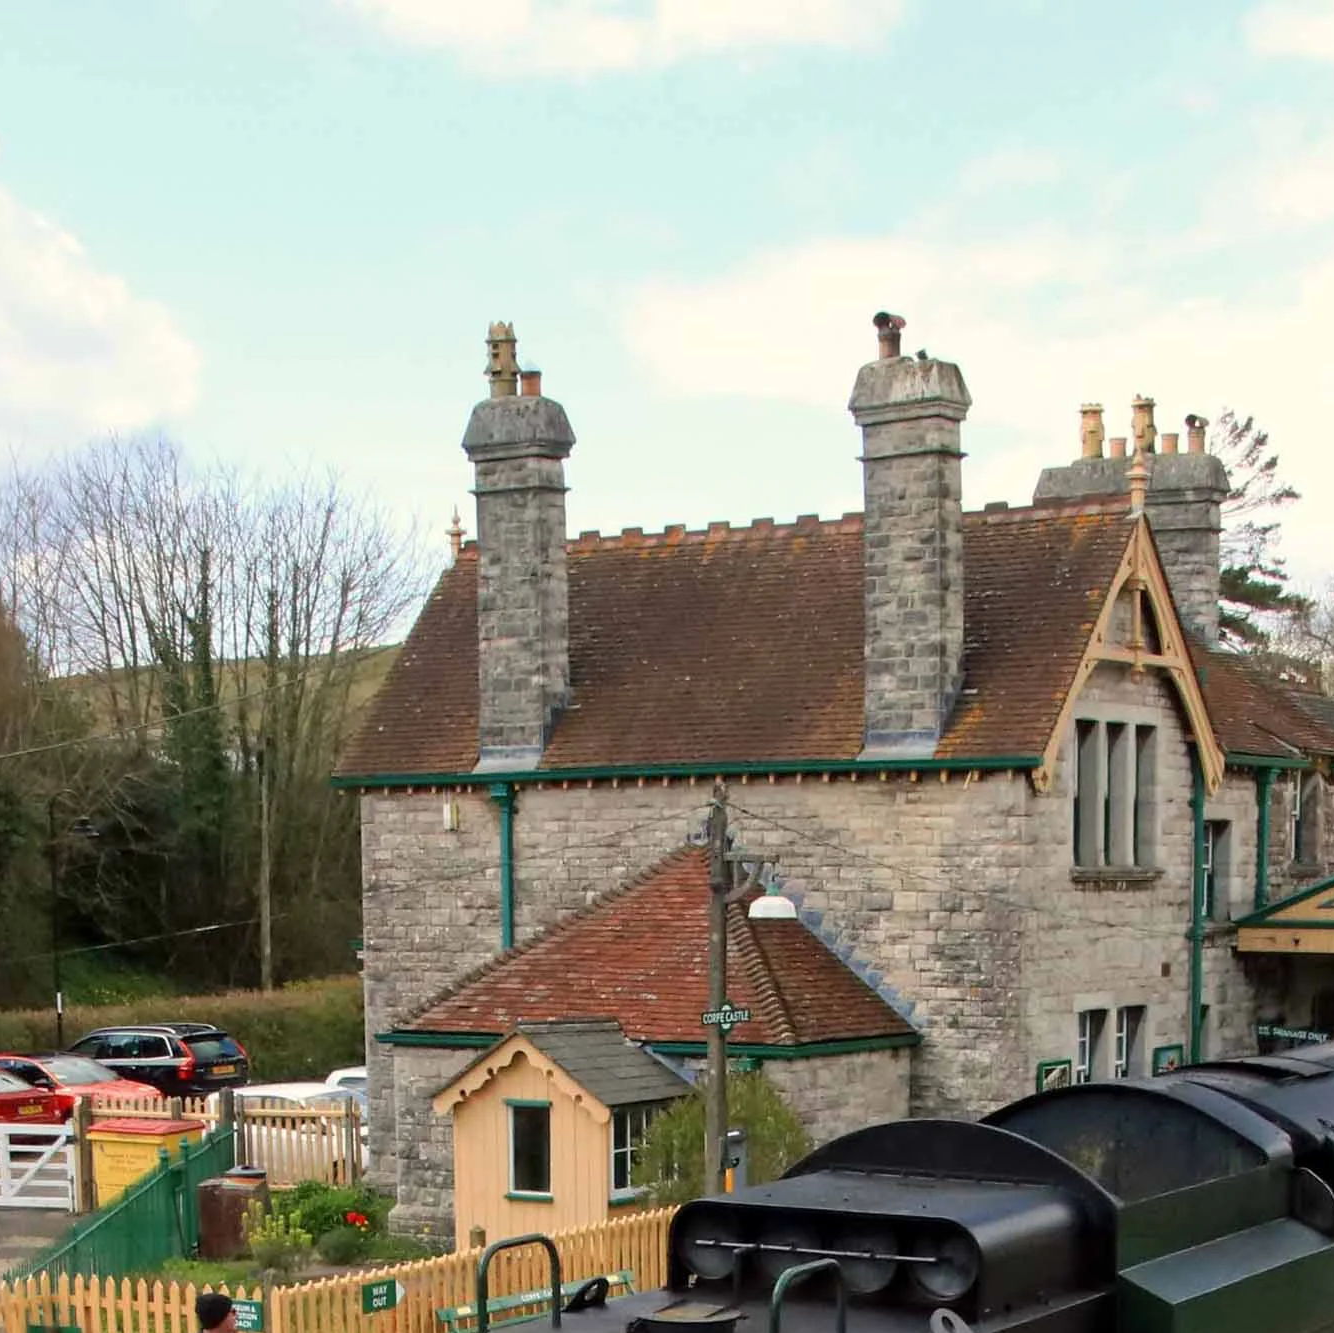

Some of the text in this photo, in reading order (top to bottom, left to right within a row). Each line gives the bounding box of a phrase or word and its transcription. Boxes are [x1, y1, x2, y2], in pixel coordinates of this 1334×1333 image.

[702, 1010, 750, 1025] CORFE CASTLE
[372, 1284, 387, 1297] WAY
[372, 1295, 387, 1308] OUT
